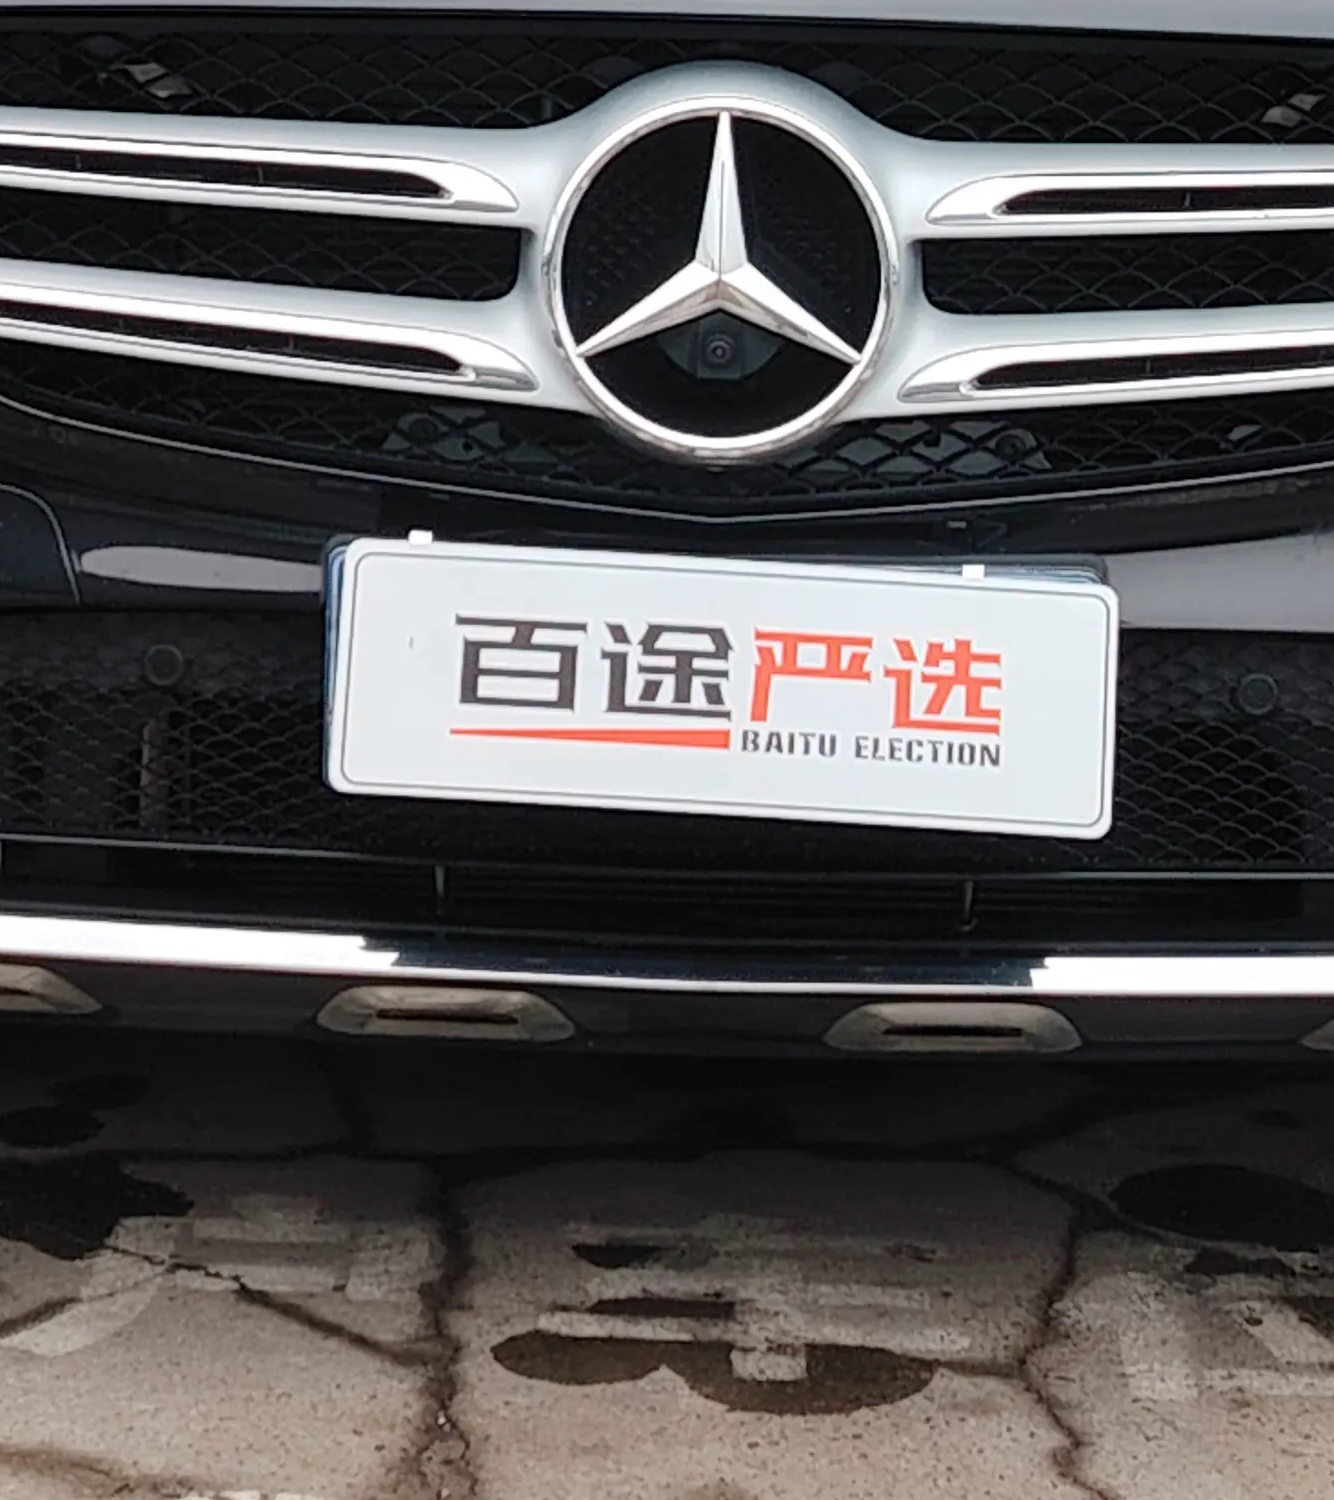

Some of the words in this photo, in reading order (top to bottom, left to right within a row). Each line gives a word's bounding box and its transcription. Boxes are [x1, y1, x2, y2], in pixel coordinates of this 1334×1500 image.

[455, 612, 1004, 736] 百途严选
[740, 729, 838, 759] BAITU
[854, 734, 1002, 768] ELECTION
